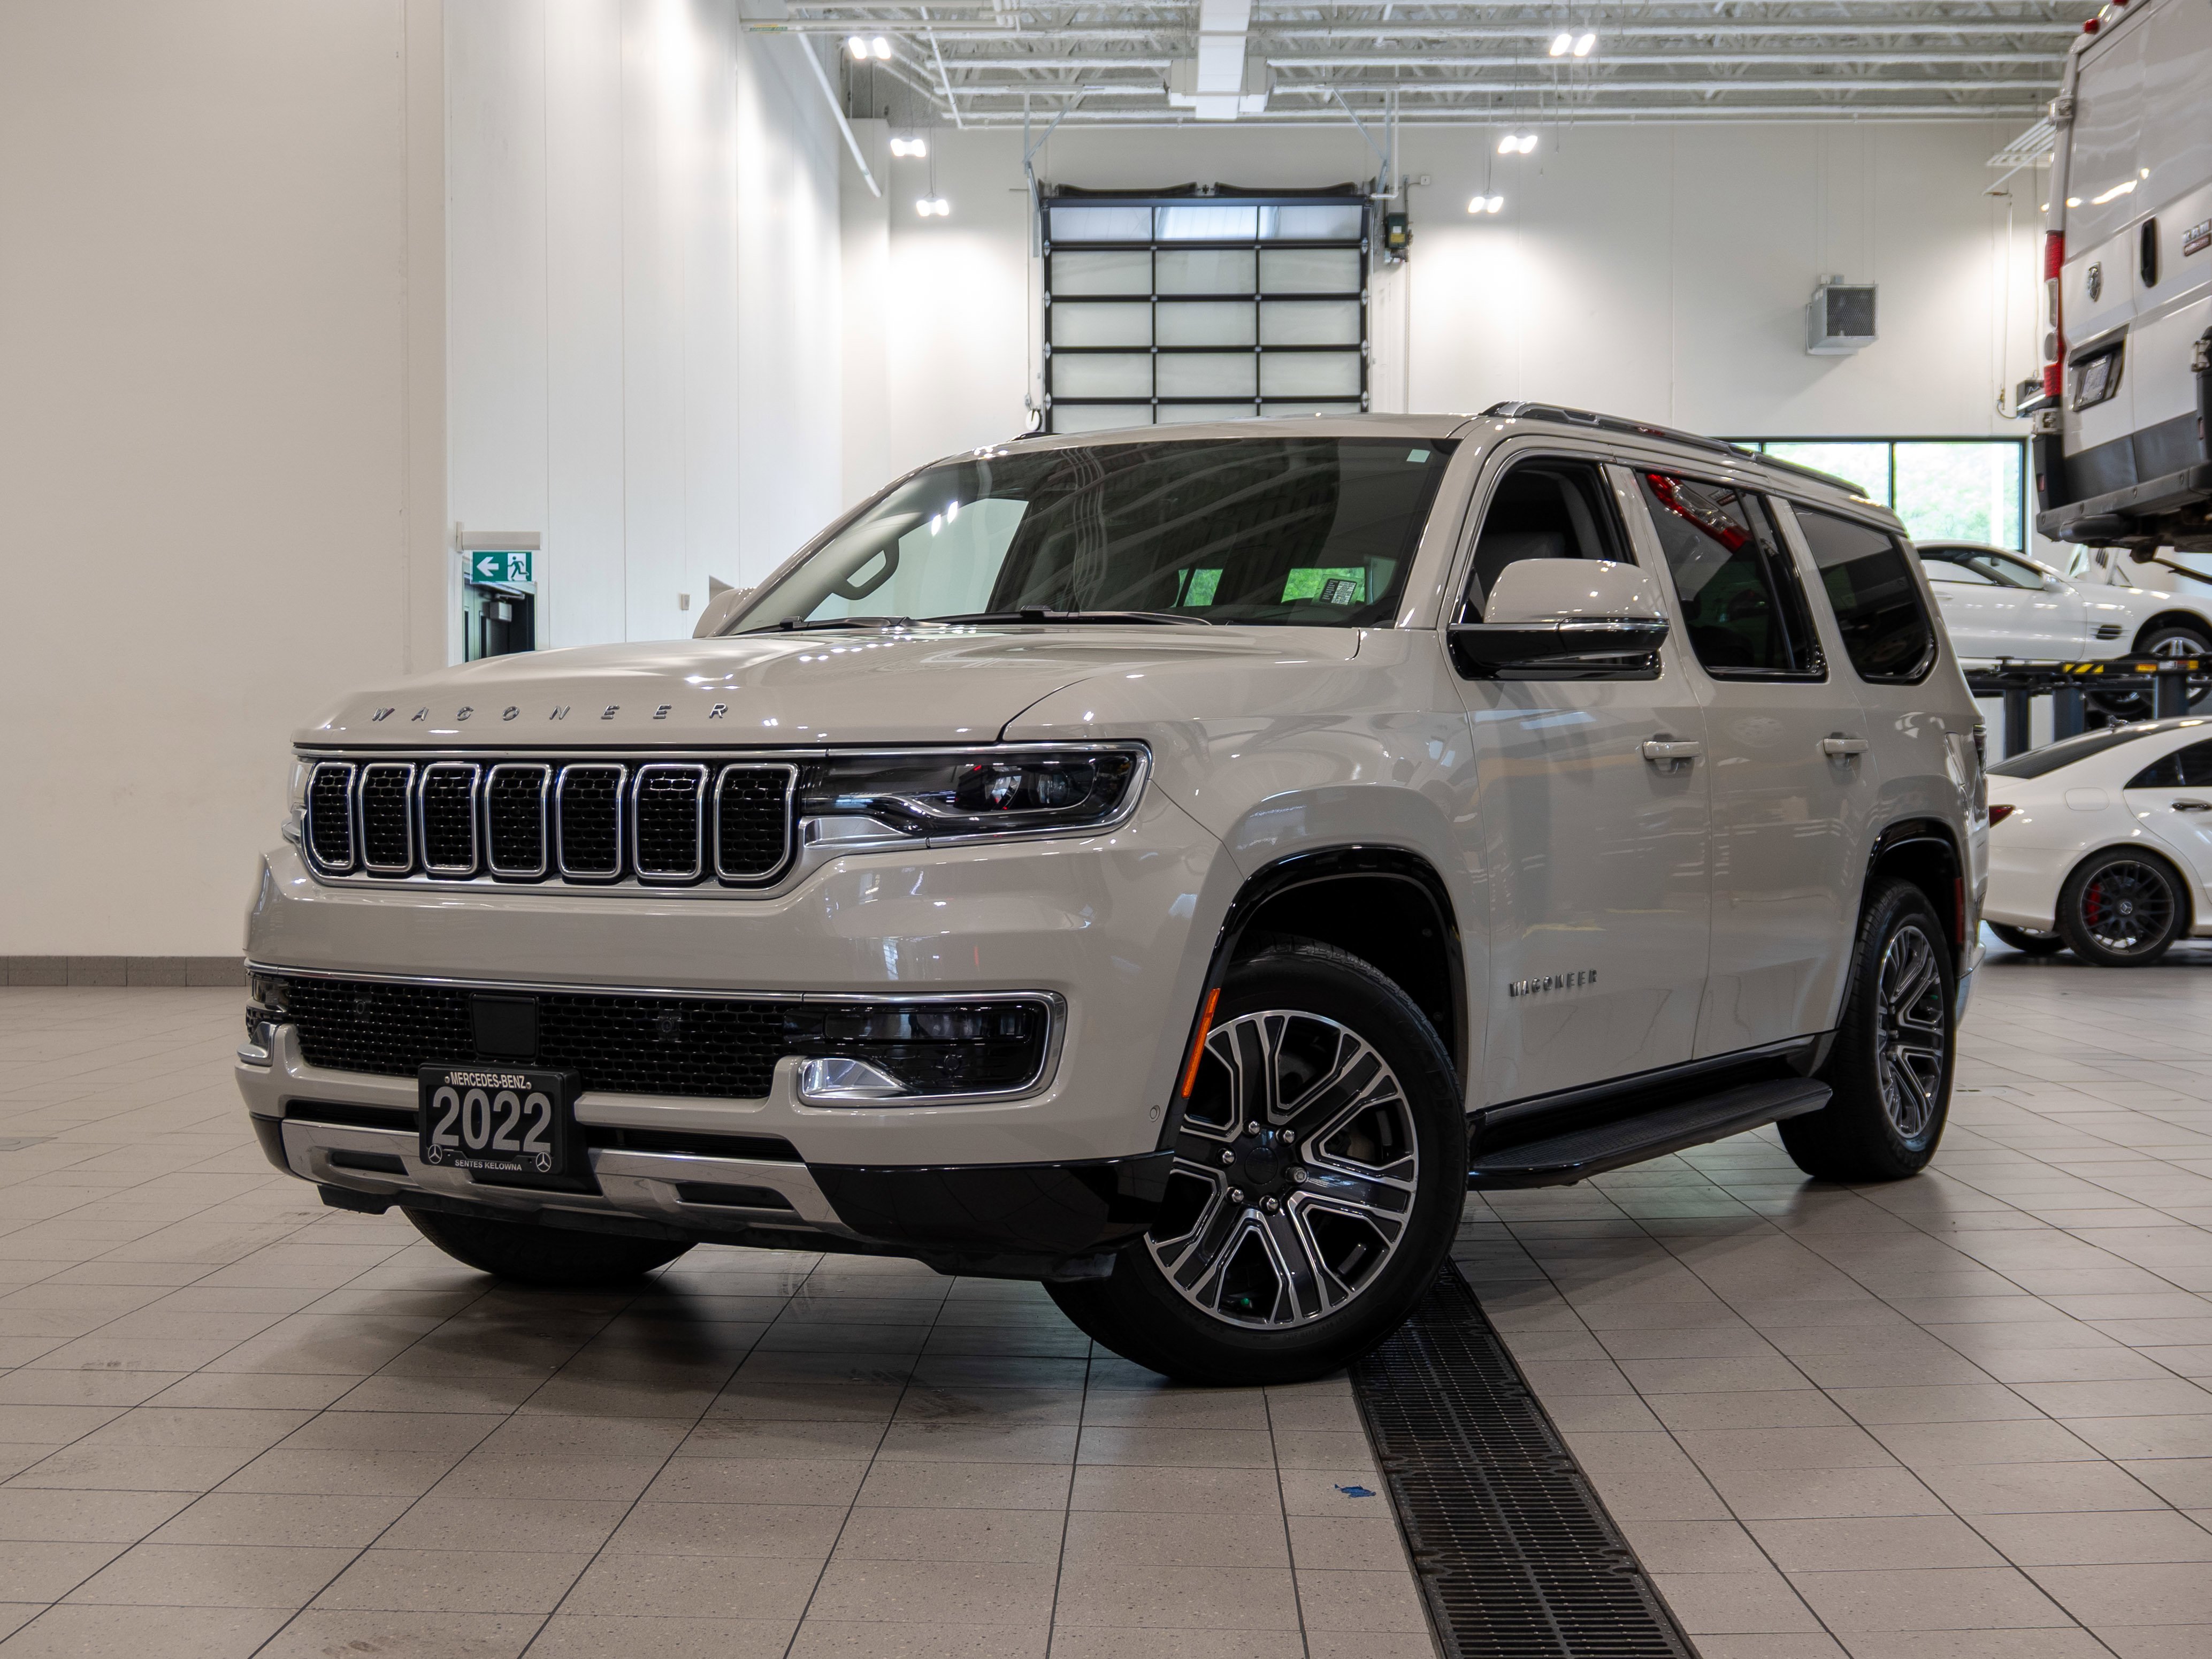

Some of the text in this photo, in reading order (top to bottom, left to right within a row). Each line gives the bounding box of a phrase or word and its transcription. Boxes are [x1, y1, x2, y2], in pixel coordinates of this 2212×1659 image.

[372, 703, 729, 722] WAGONEER
[1509, 969, 1597, 997] WAGONEER
[450, 1072, 526, 1089] MERCEDES-BENZ
[432, 1086, 552, 1153] 2022
[455, 1159, 522, 1171] SENTES KELOWNA
